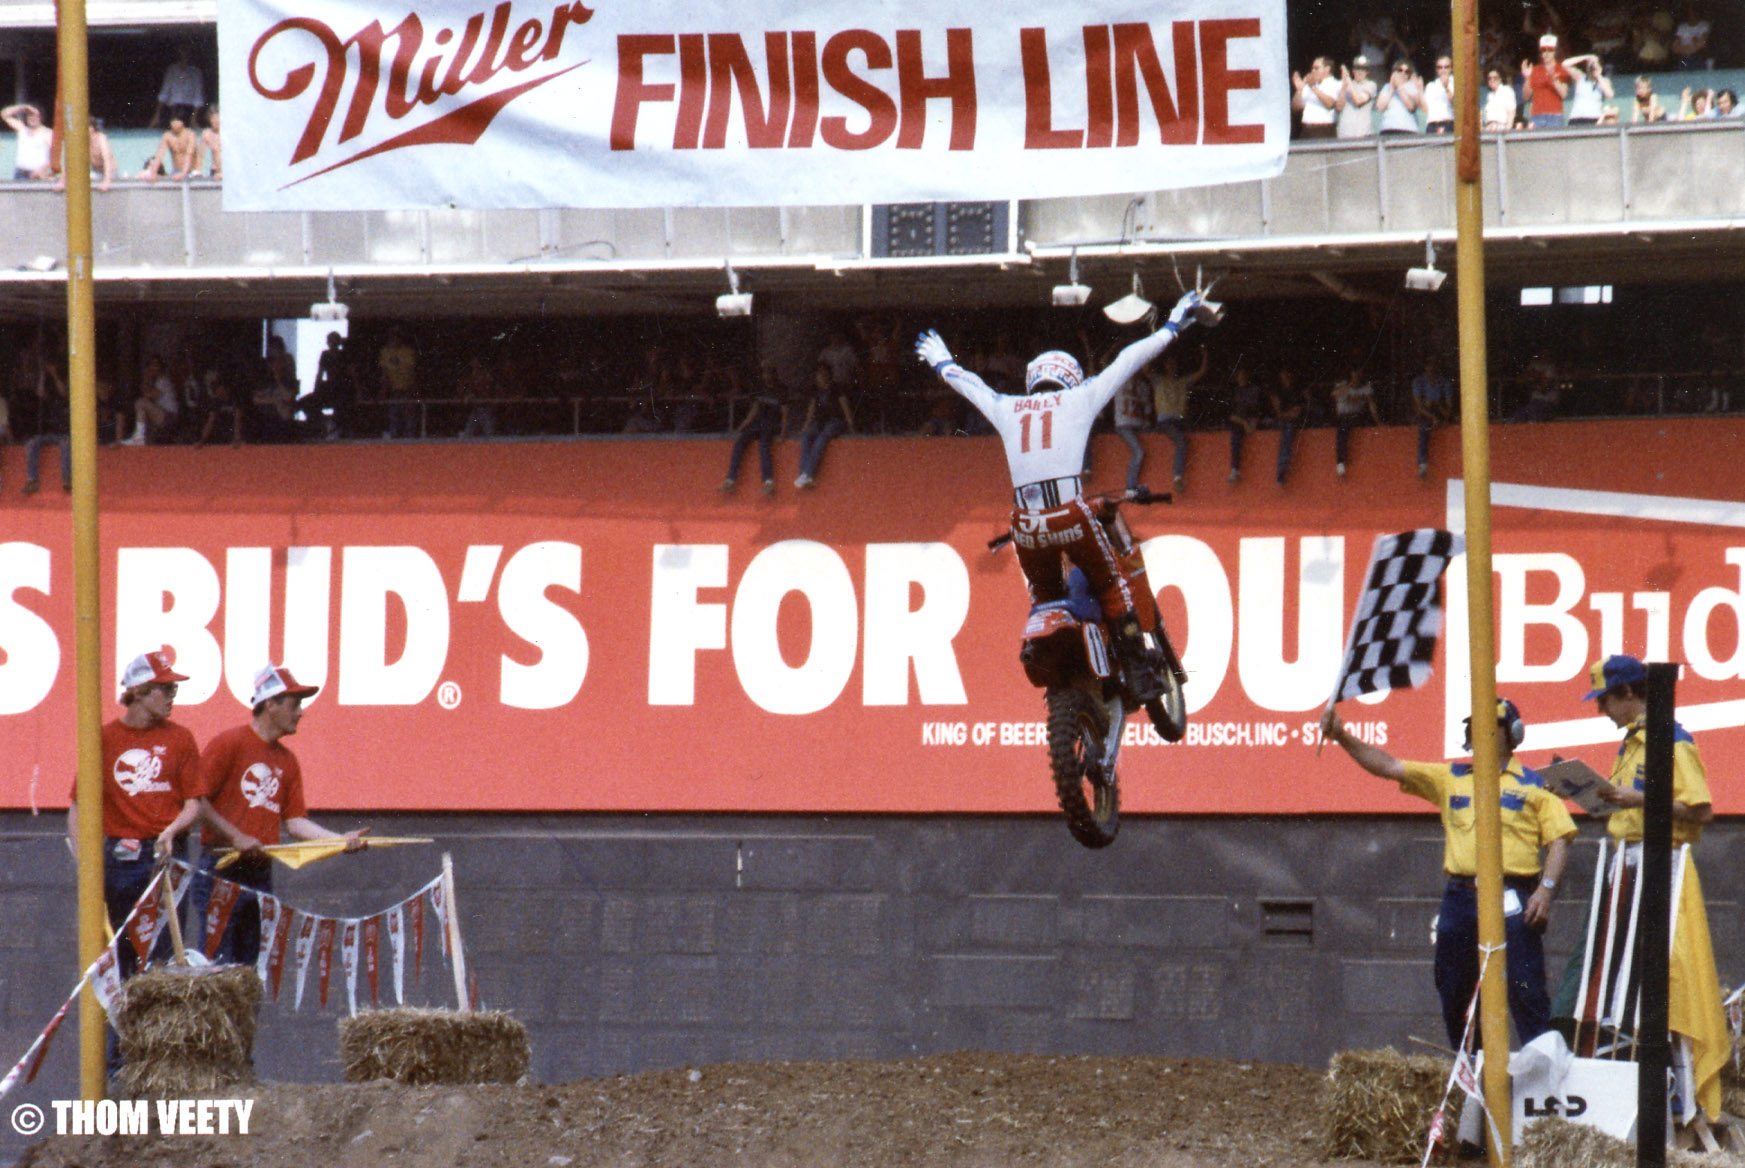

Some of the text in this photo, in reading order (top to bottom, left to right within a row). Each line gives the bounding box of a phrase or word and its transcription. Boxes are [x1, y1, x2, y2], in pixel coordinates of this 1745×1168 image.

[248, 0, 1265, 166] Miller FINISH LINE
[1019, 410, 1053, 453] 11
[115, 541, 589, 709] BUD'S
[648, 539, 970, 715] FOR
[922, 722, 968, 746] KING
[972, 722, 997, 746] OF
[1000, 722, 1050, 746] BEER
